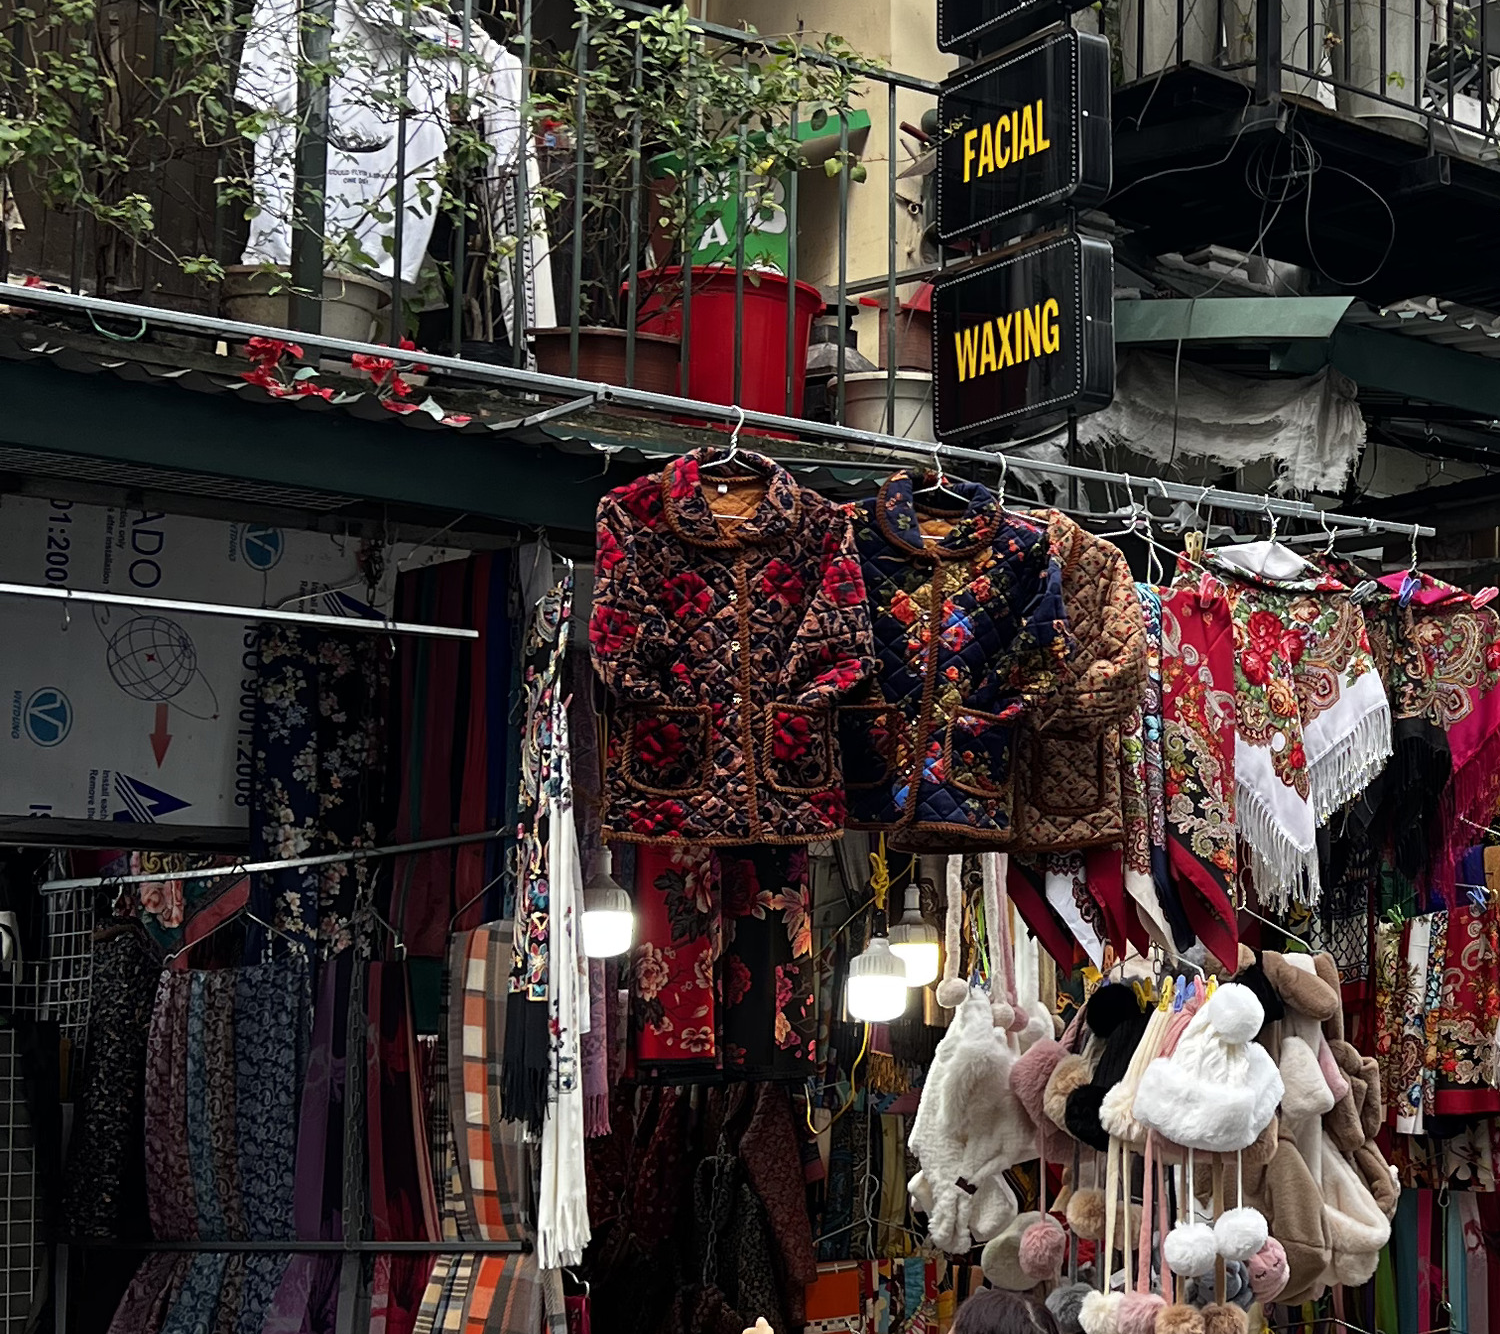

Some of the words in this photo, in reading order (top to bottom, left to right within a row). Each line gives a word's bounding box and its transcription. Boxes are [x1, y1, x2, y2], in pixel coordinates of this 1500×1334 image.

[963, 98, 1050, 183] FACIAL
[953, 296, 1060, 383] WAXING
[88, 769, 99, 806] Remove
[101, 770, 111, 797] Install
